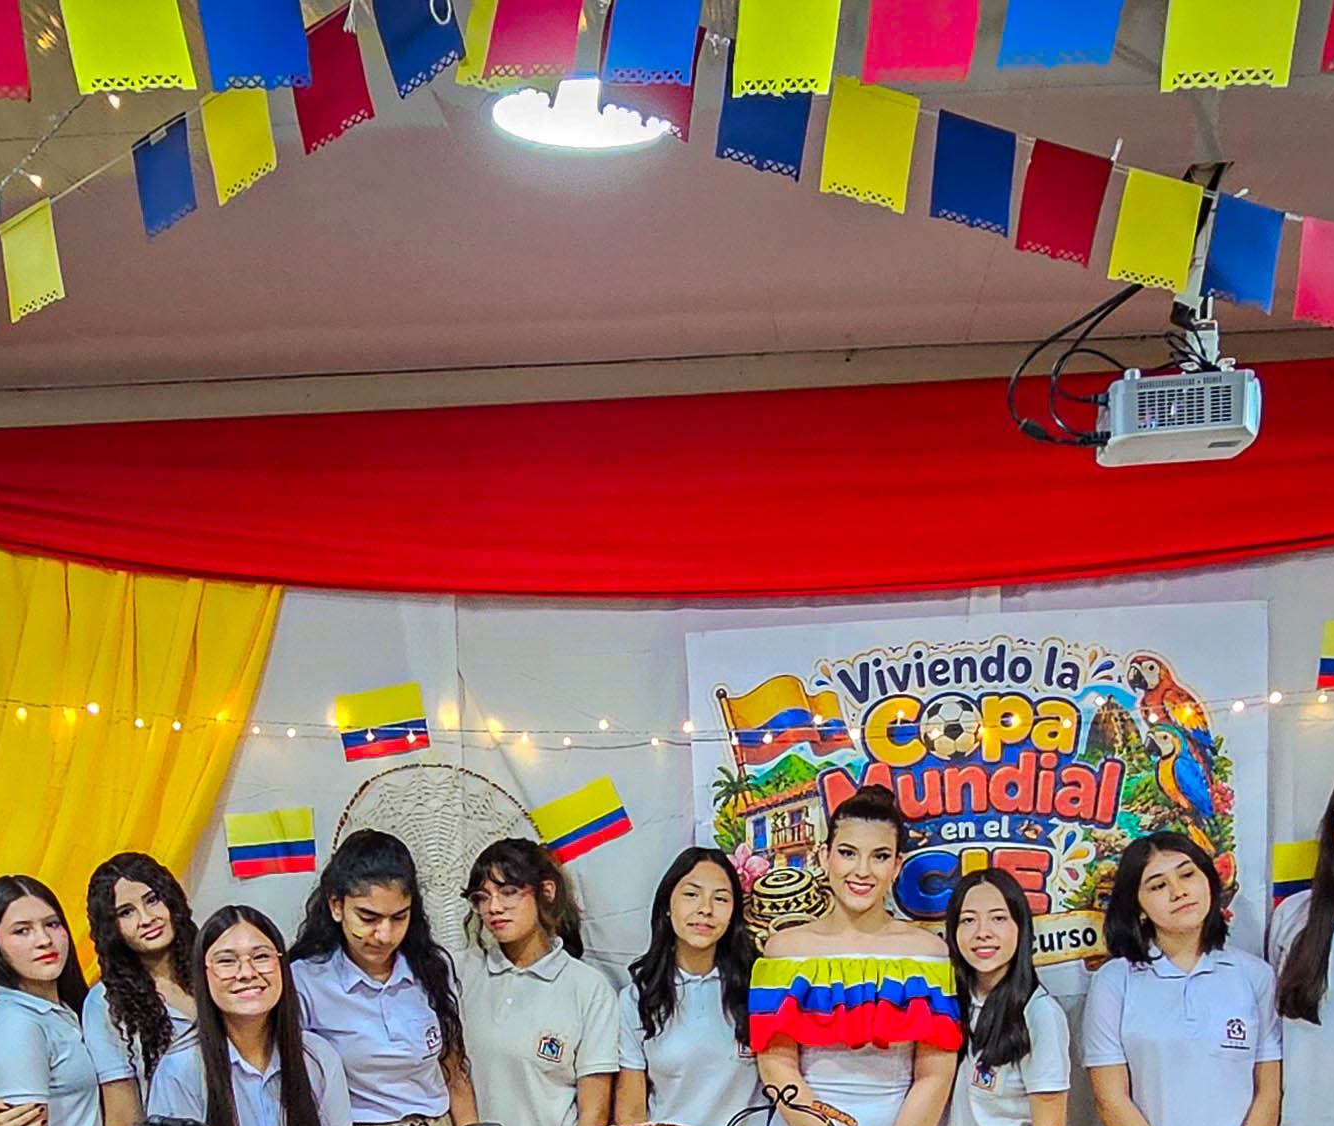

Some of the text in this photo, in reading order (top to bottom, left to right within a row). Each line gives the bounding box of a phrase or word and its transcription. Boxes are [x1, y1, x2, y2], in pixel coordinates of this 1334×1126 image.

[837, 646, 1080, 703] Viviendo la
[819, 752, 1123, 829] Mundial
[940, 815, 1011, 841] en el
